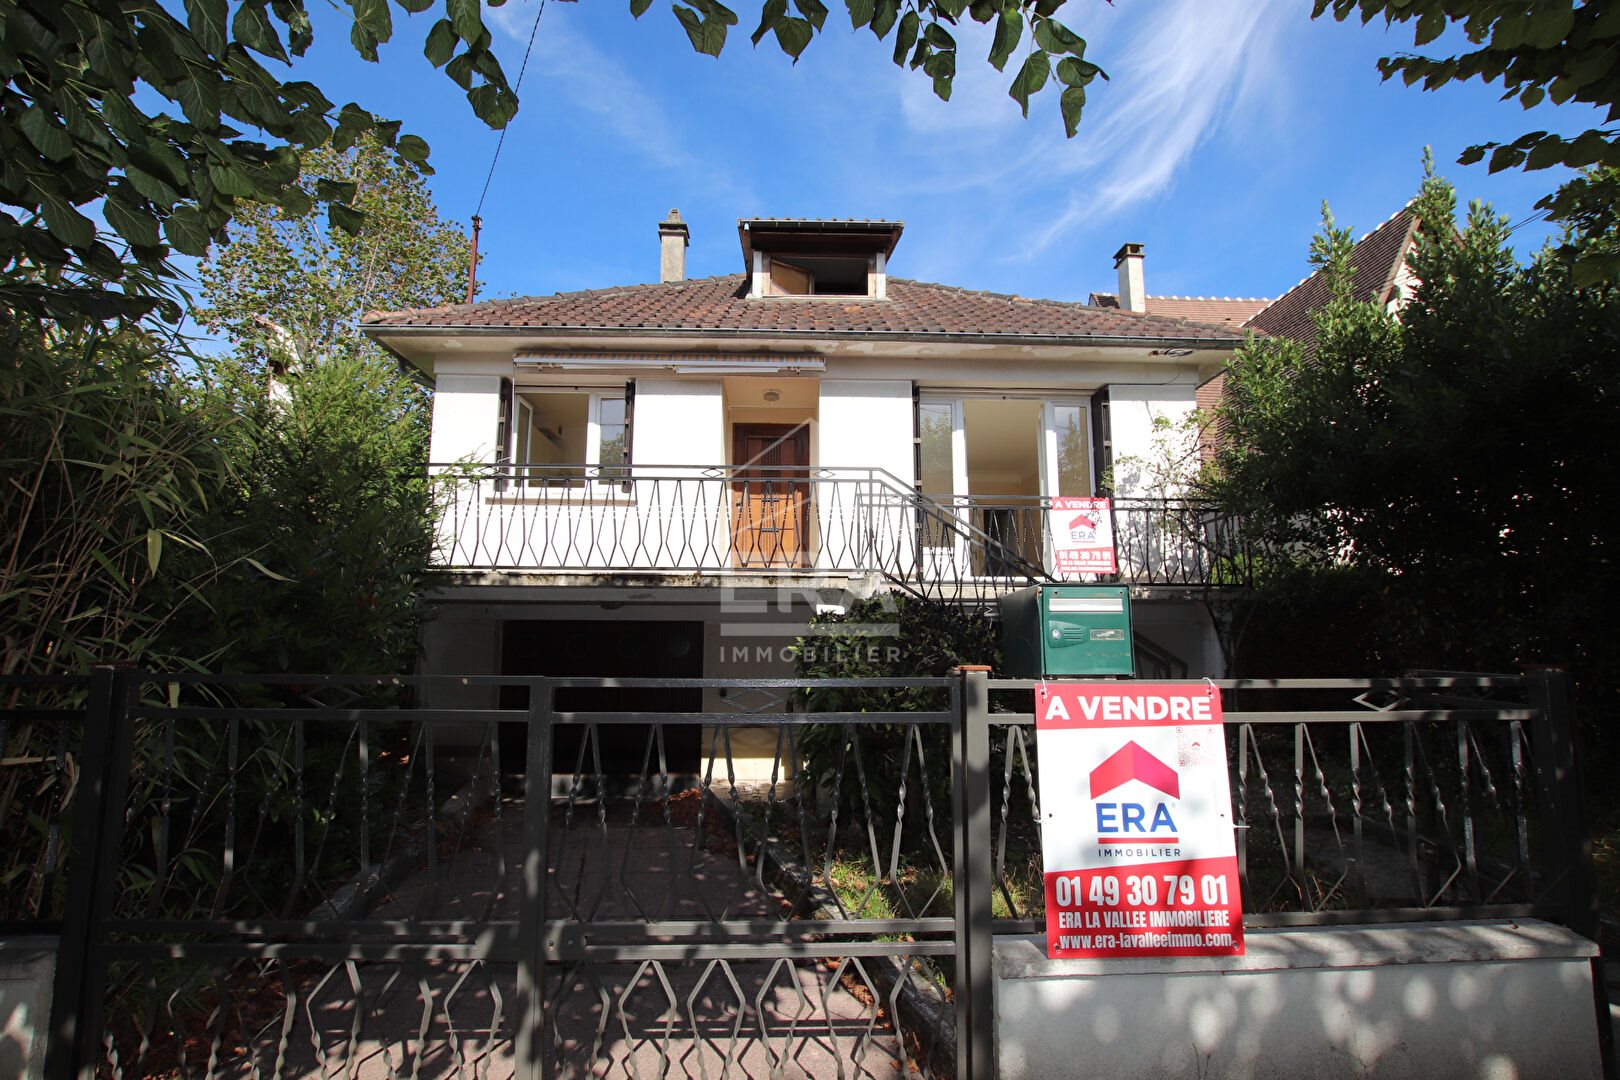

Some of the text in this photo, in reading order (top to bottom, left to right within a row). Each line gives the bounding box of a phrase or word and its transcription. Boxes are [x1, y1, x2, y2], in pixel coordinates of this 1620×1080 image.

[1055, 501, 1063, 509] A
[1071, 531, 1095, 540] ERA
[1045, 695, 1213, 721] A VENDRE
[1095, 802, 1178, 833] ERA
[1098, 848, 1181, 857] IMMOBILIER
[1055, 874, 1228, 907] 01 49 30 79 01
[1058, 910, 1230, 929] ERA LA VALLEE IMMOBILIERE
[1059, 931, 1232, 949] www.era-lavalleeimmo.com
